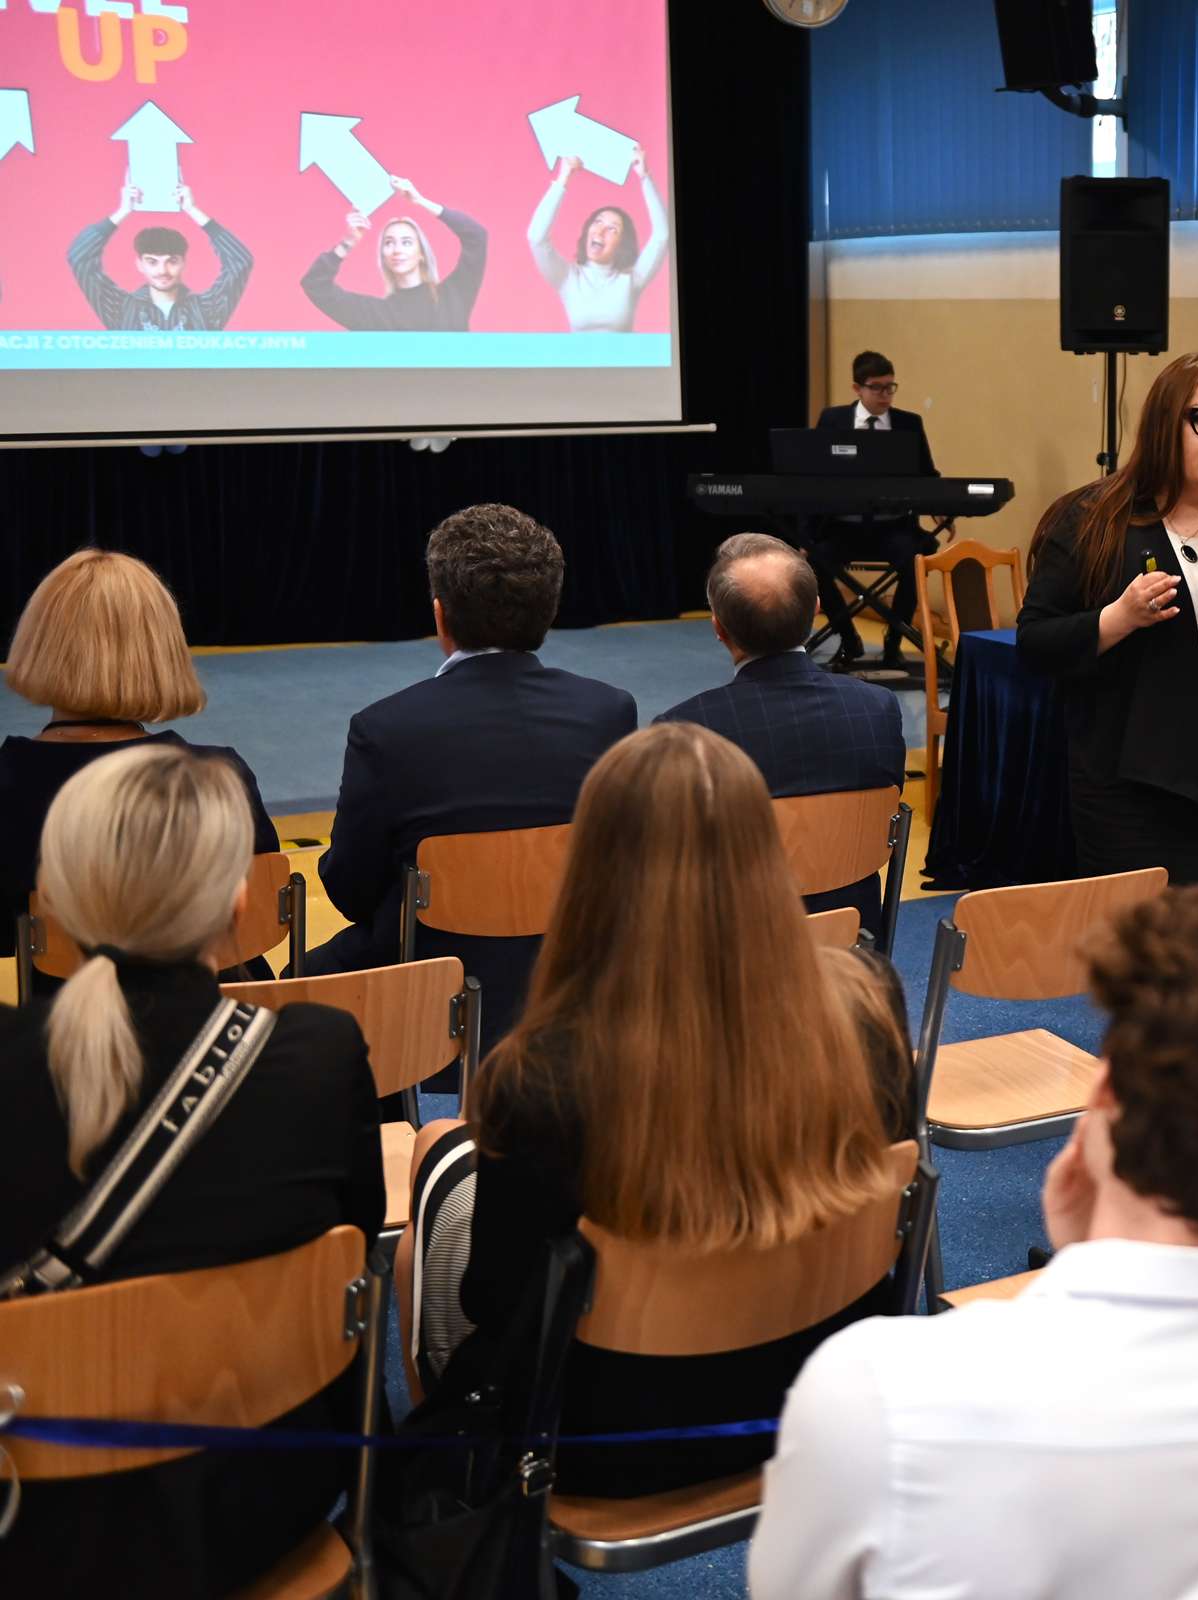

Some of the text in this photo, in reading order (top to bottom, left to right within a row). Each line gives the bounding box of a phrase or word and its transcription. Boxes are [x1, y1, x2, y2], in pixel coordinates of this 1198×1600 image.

[57, 6, 189, 84] UP
[57, 335, 173, 350] OTOCZENIEM
[707, 484, 743, 495] YAMAHA
